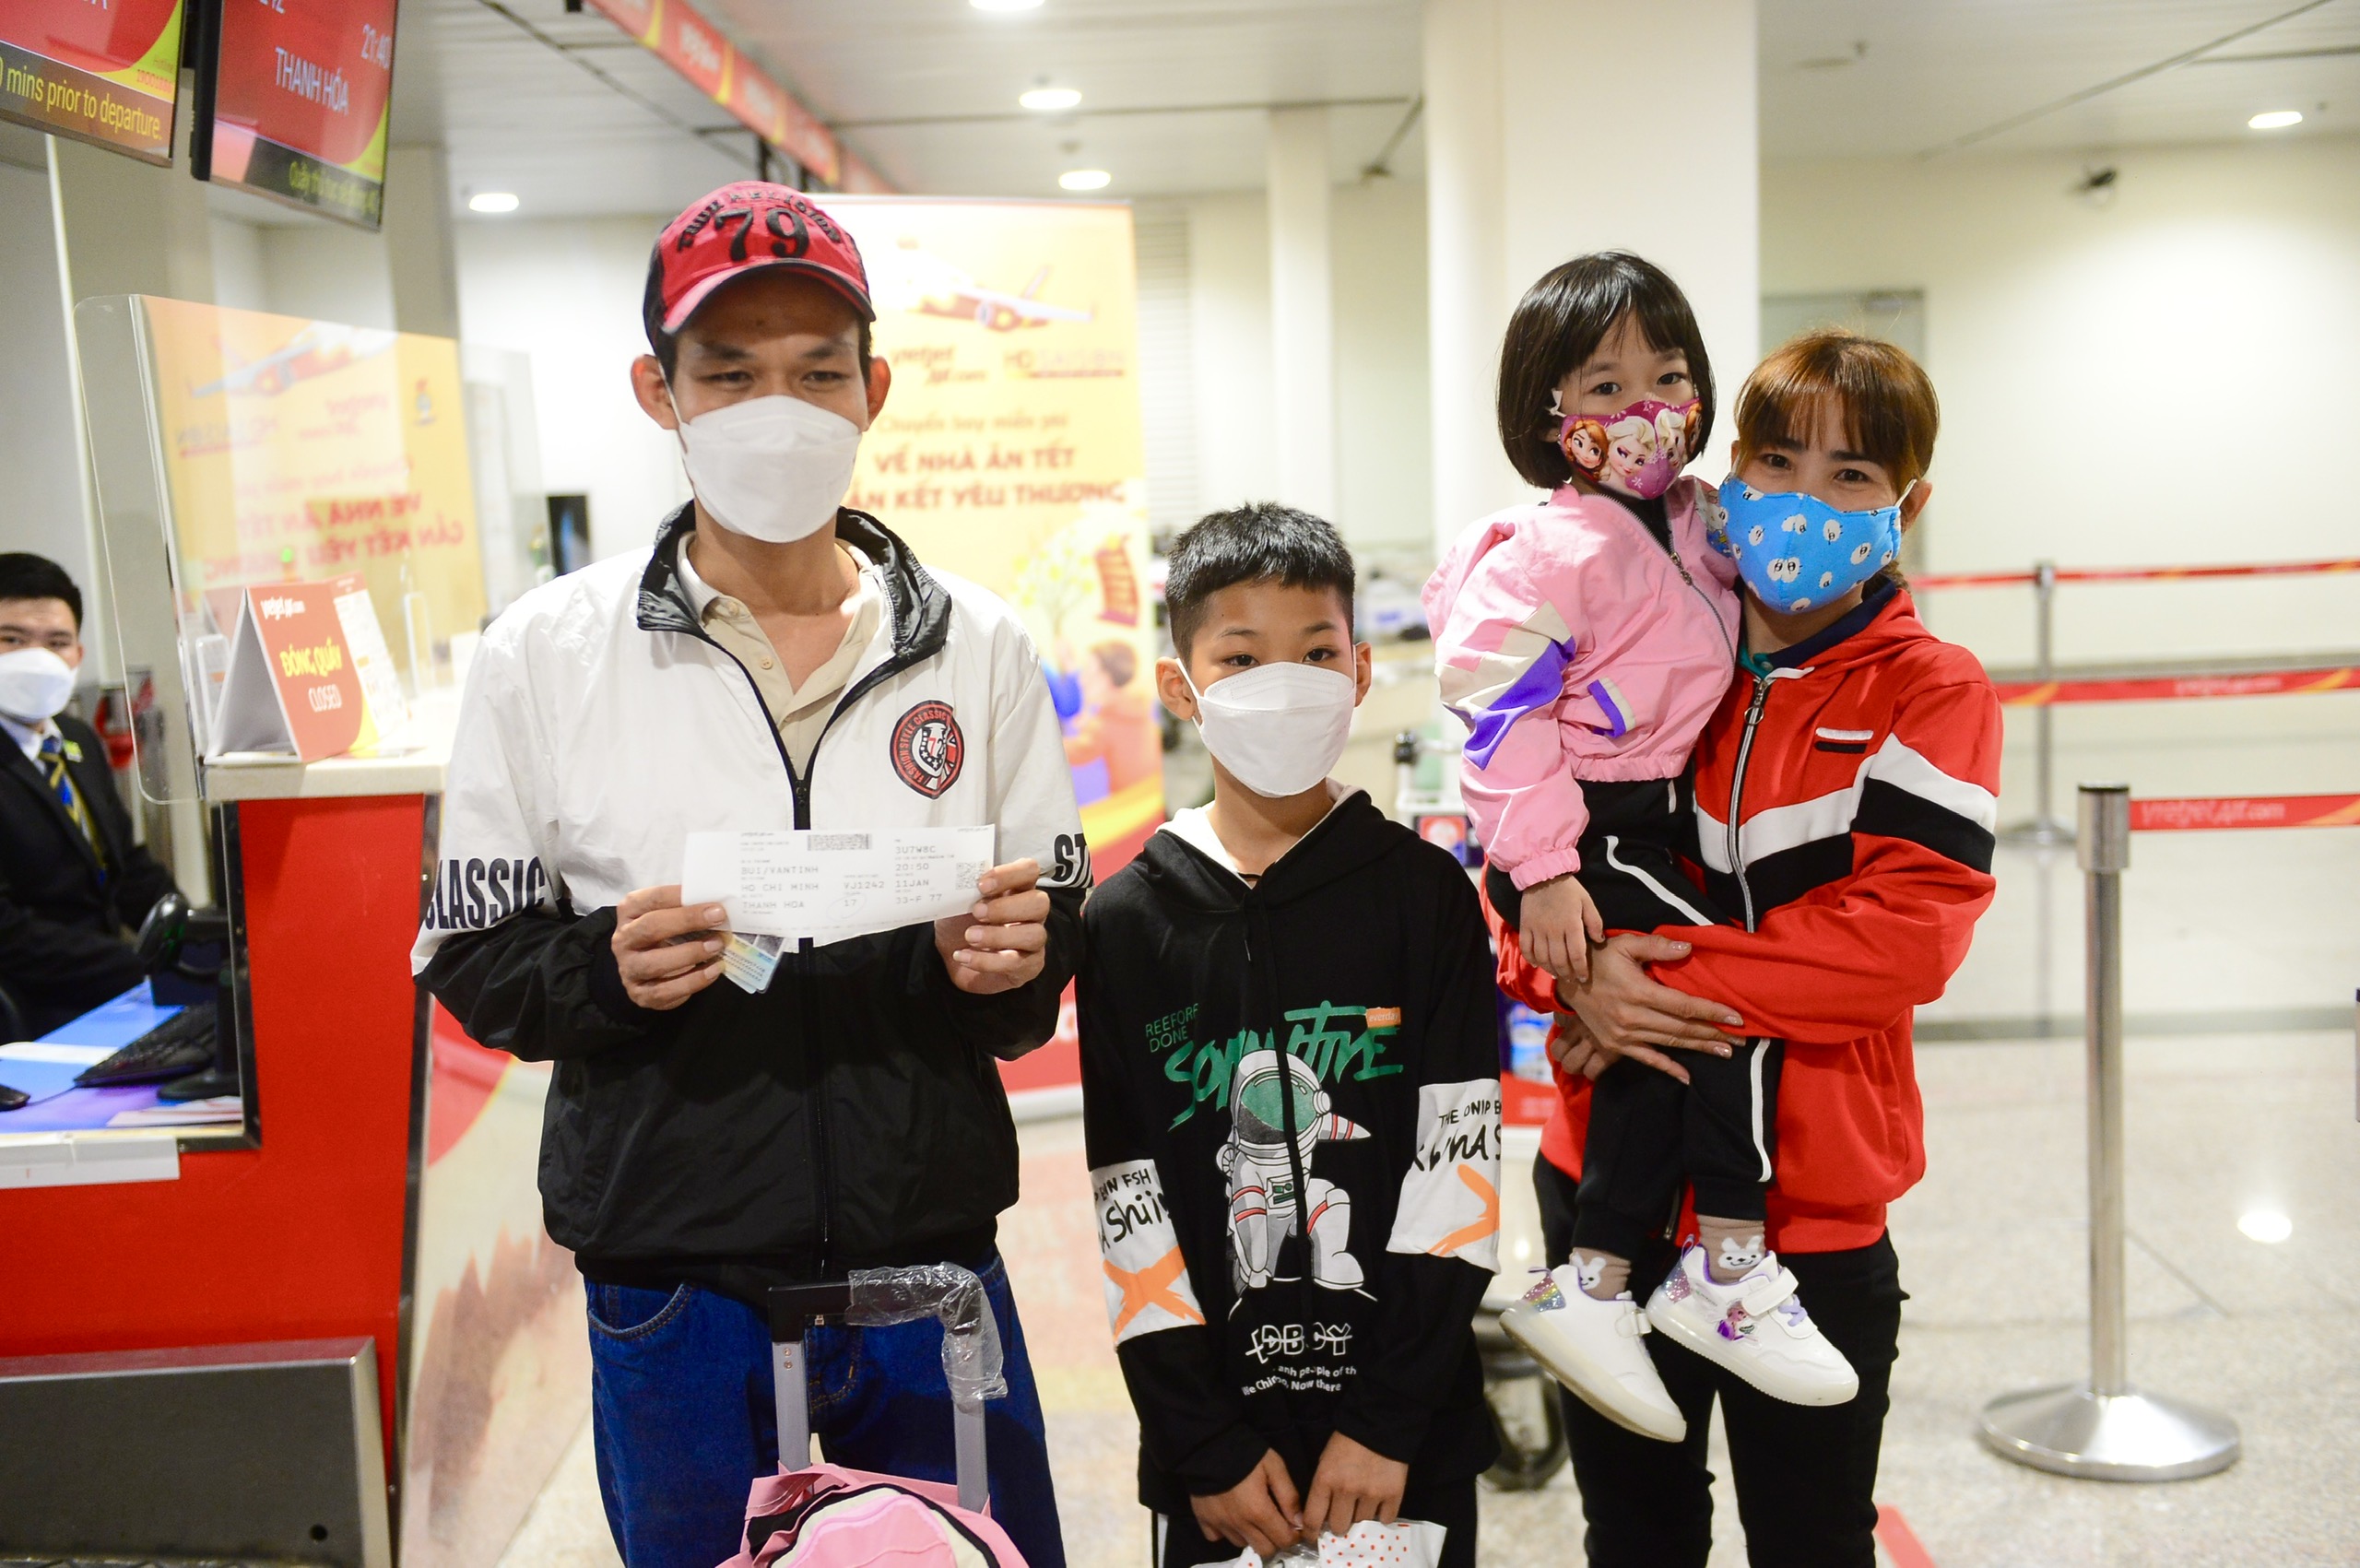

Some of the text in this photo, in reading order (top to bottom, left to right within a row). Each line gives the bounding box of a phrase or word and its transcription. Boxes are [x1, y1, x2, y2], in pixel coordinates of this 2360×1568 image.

[275, 46, 349, 116] THANH HÓA
[6, 65, 45, 102] mins
[47, 79, 81, 112] prior
[83, 89, 97, 119] to
[100, 93, 163, 141] departure.
[714, 206, 809, 262] 79
[308, 684, 342, 713] CLOSED
[899, 723, 916, 749] STYLE
[894, 862, 930, 872] 20:50
[740, 882, 820, 892] HO CHI MINH
[894, 878, 930, 889] 11JAN
[742, 900, 805, 909] THANH HOA
[1148, 1026, 1189, 1054] DONE
[1438, 1109, 1459, 1128] THE
[1121, 1168, 1151, 1188] FSH
[1291, 1379, 1315, 1391] Now
[1315, 1379, 1343, 1393] there
